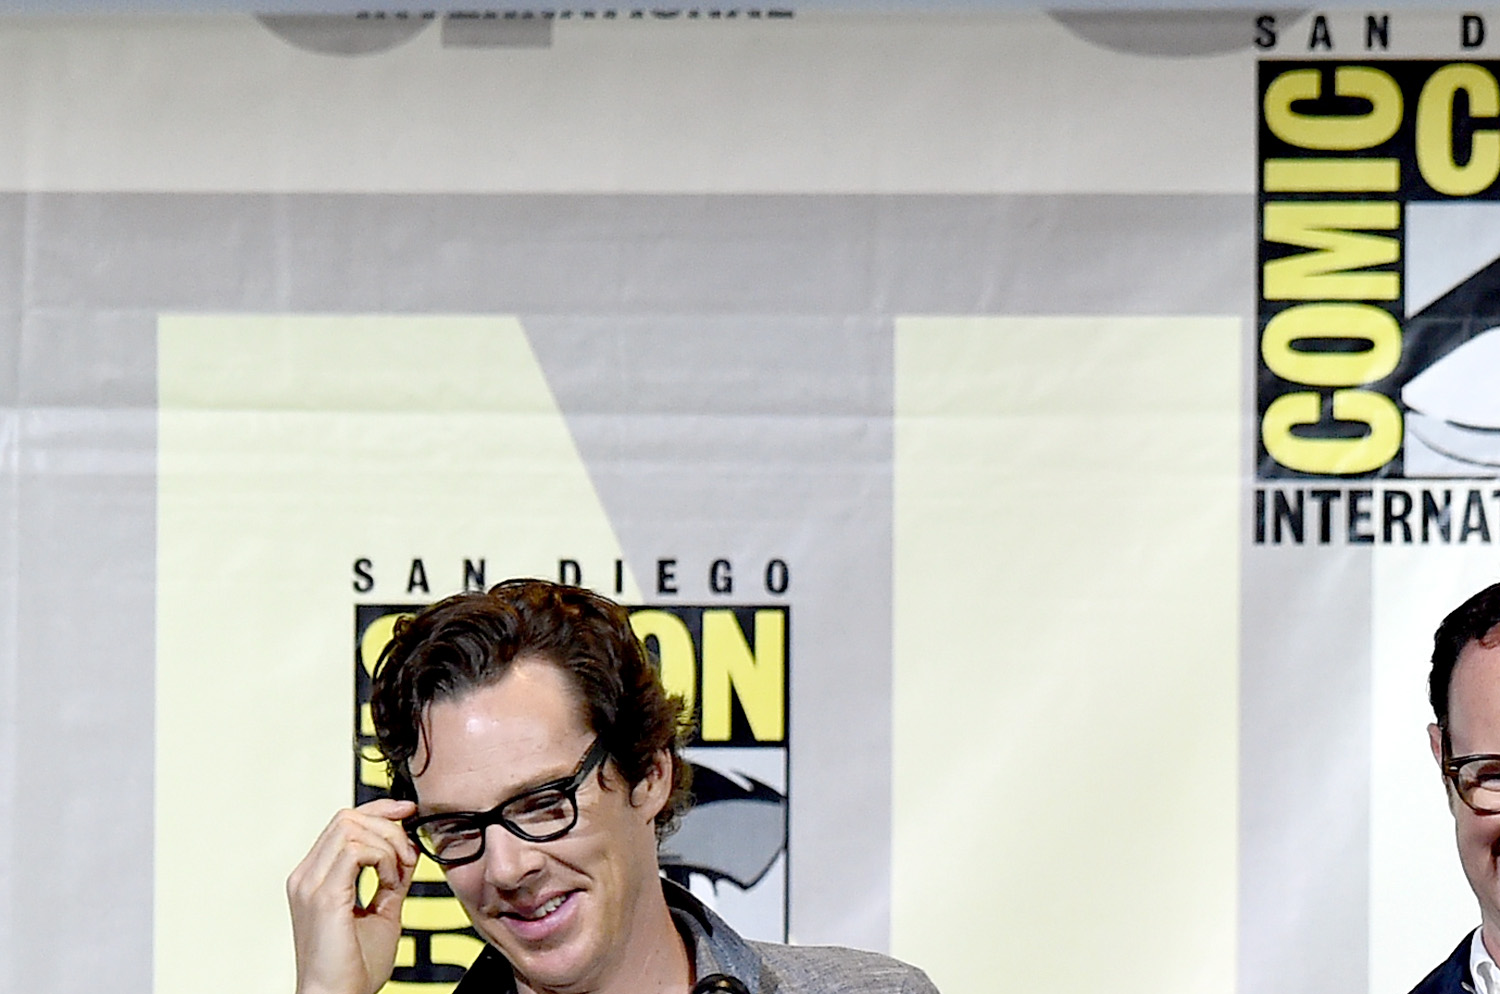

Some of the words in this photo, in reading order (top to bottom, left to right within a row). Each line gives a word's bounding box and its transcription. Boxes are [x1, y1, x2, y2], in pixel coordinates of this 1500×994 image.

[1254, 15, 1389, 49] SAN
[1261, 65, 1404, 475] COMIC
[353, 558, 486, 593] SAN
[559, 558, 790, 595] DIEGO
